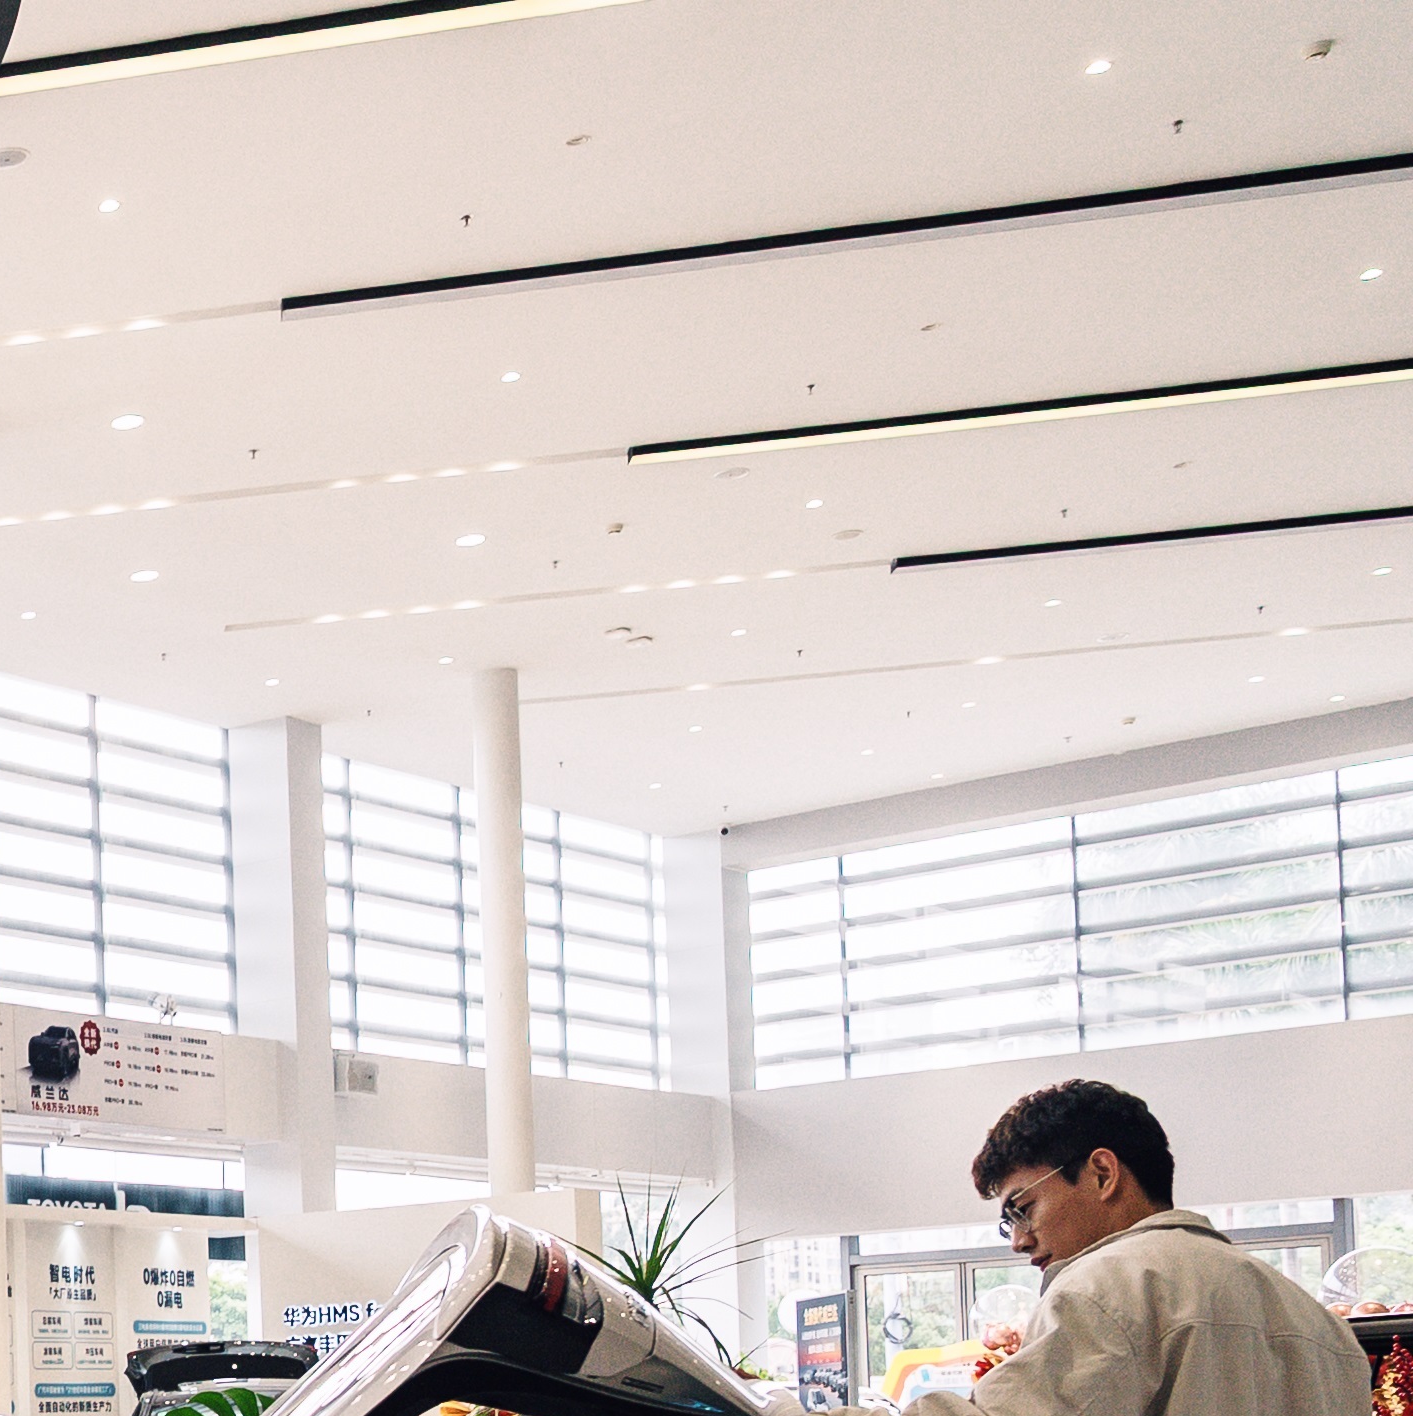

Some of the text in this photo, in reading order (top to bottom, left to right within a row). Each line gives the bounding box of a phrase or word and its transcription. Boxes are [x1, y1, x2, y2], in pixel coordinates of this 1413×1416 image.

[49, 1264, 95, 1285] 智电时代
[143, 1268, 195, 1287] 0爆炸0自燃
[157, 1291, 183, 1309] 0漏电
[284, 1305, 359, 1326] 华为HMS
